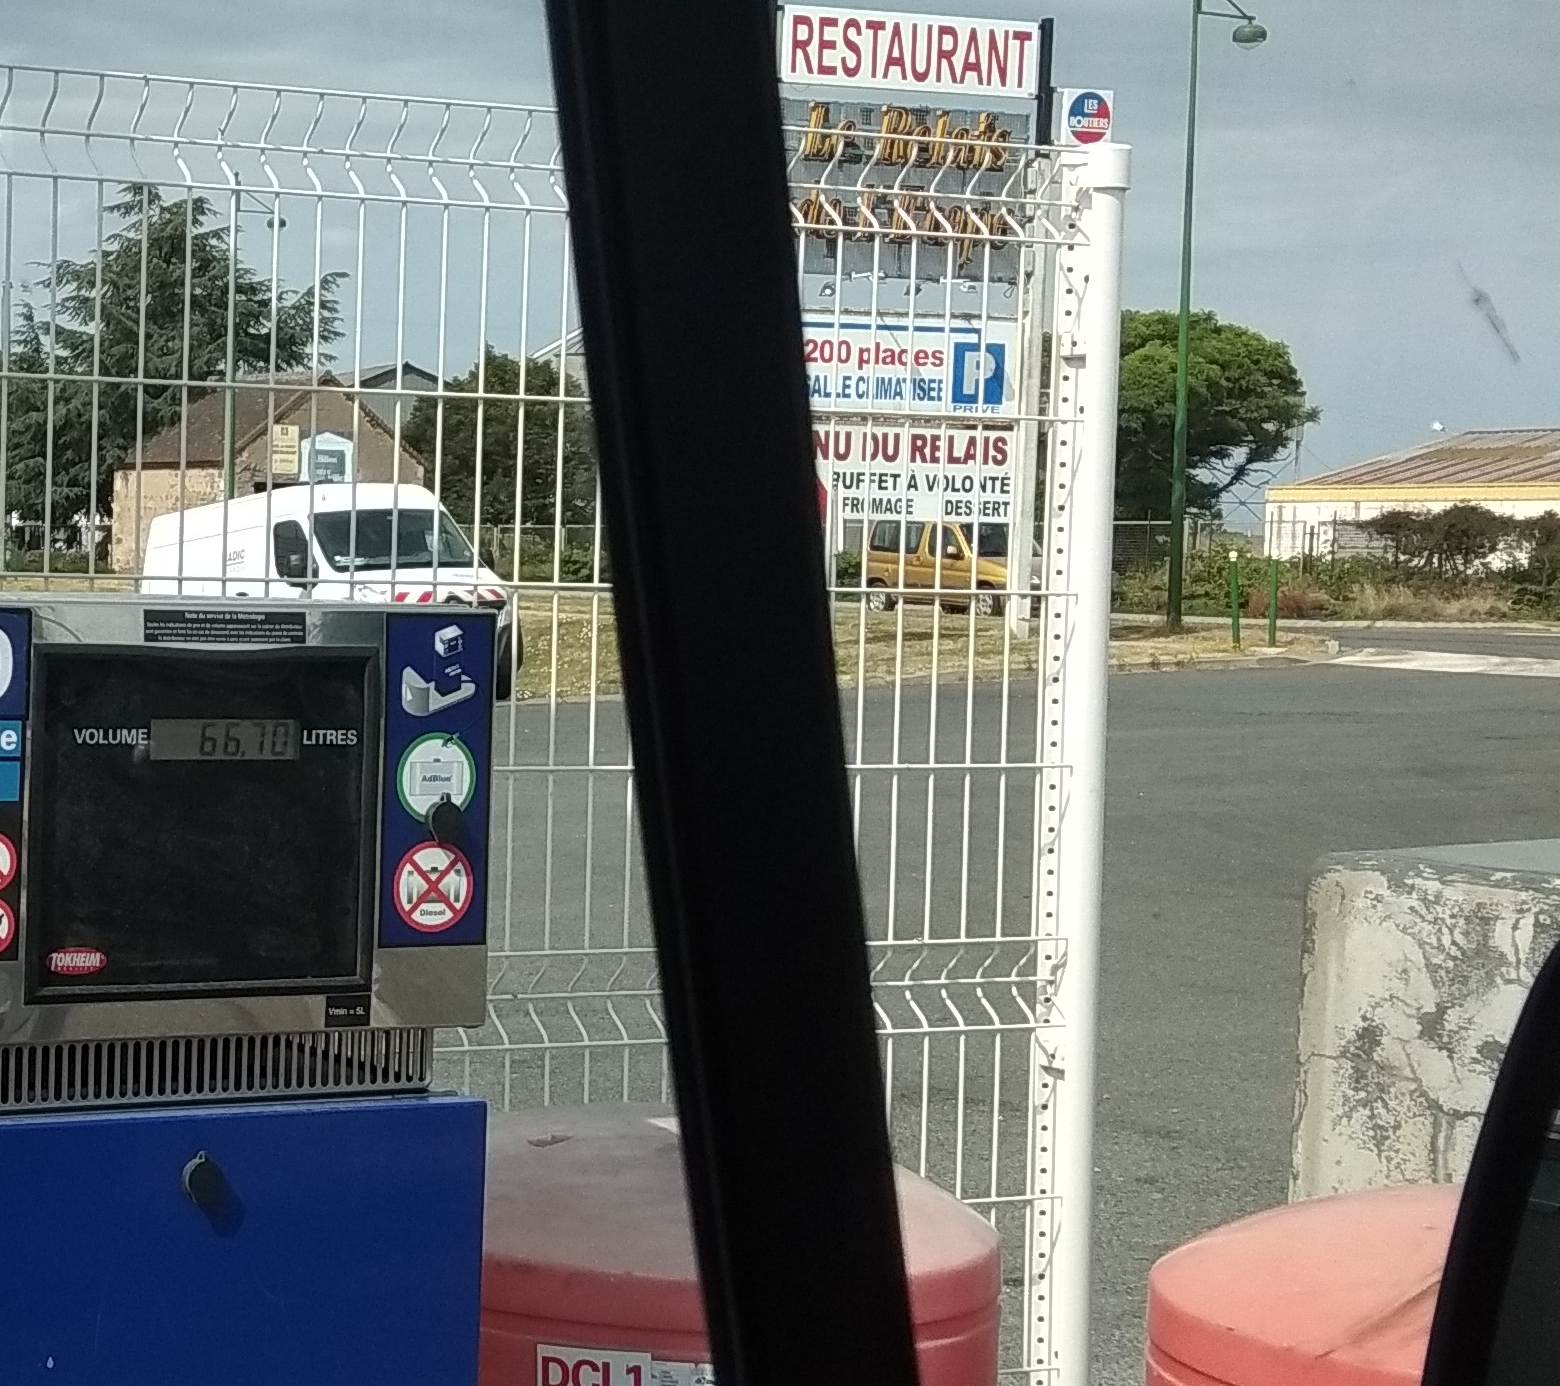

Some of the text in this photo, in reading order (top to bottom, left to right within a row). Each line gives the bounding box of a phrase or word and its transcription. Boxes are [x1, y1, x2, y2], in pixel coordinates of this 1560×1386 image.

[790, 14, 1033, 88] RESTAURANT
[1083, 98, 1099, 113] LES
[804, 339, 945, 370] 200 places
[855, 376, 943, 402] CLIMAISEE
[813, 430, 1008, 466] NU DU RELAIS
[833, 469, 1011, 494] BUFFET À VOLONTÉ
[842, 497, 1011, 518] FROMAGE DESSERT
[74, 728, 148, 745] VOLUME
[302, 729, 358, 745] LITRES
[419, 908, 446, 916] Diesel
[48, 952, 102, 971] TOKHEIM
